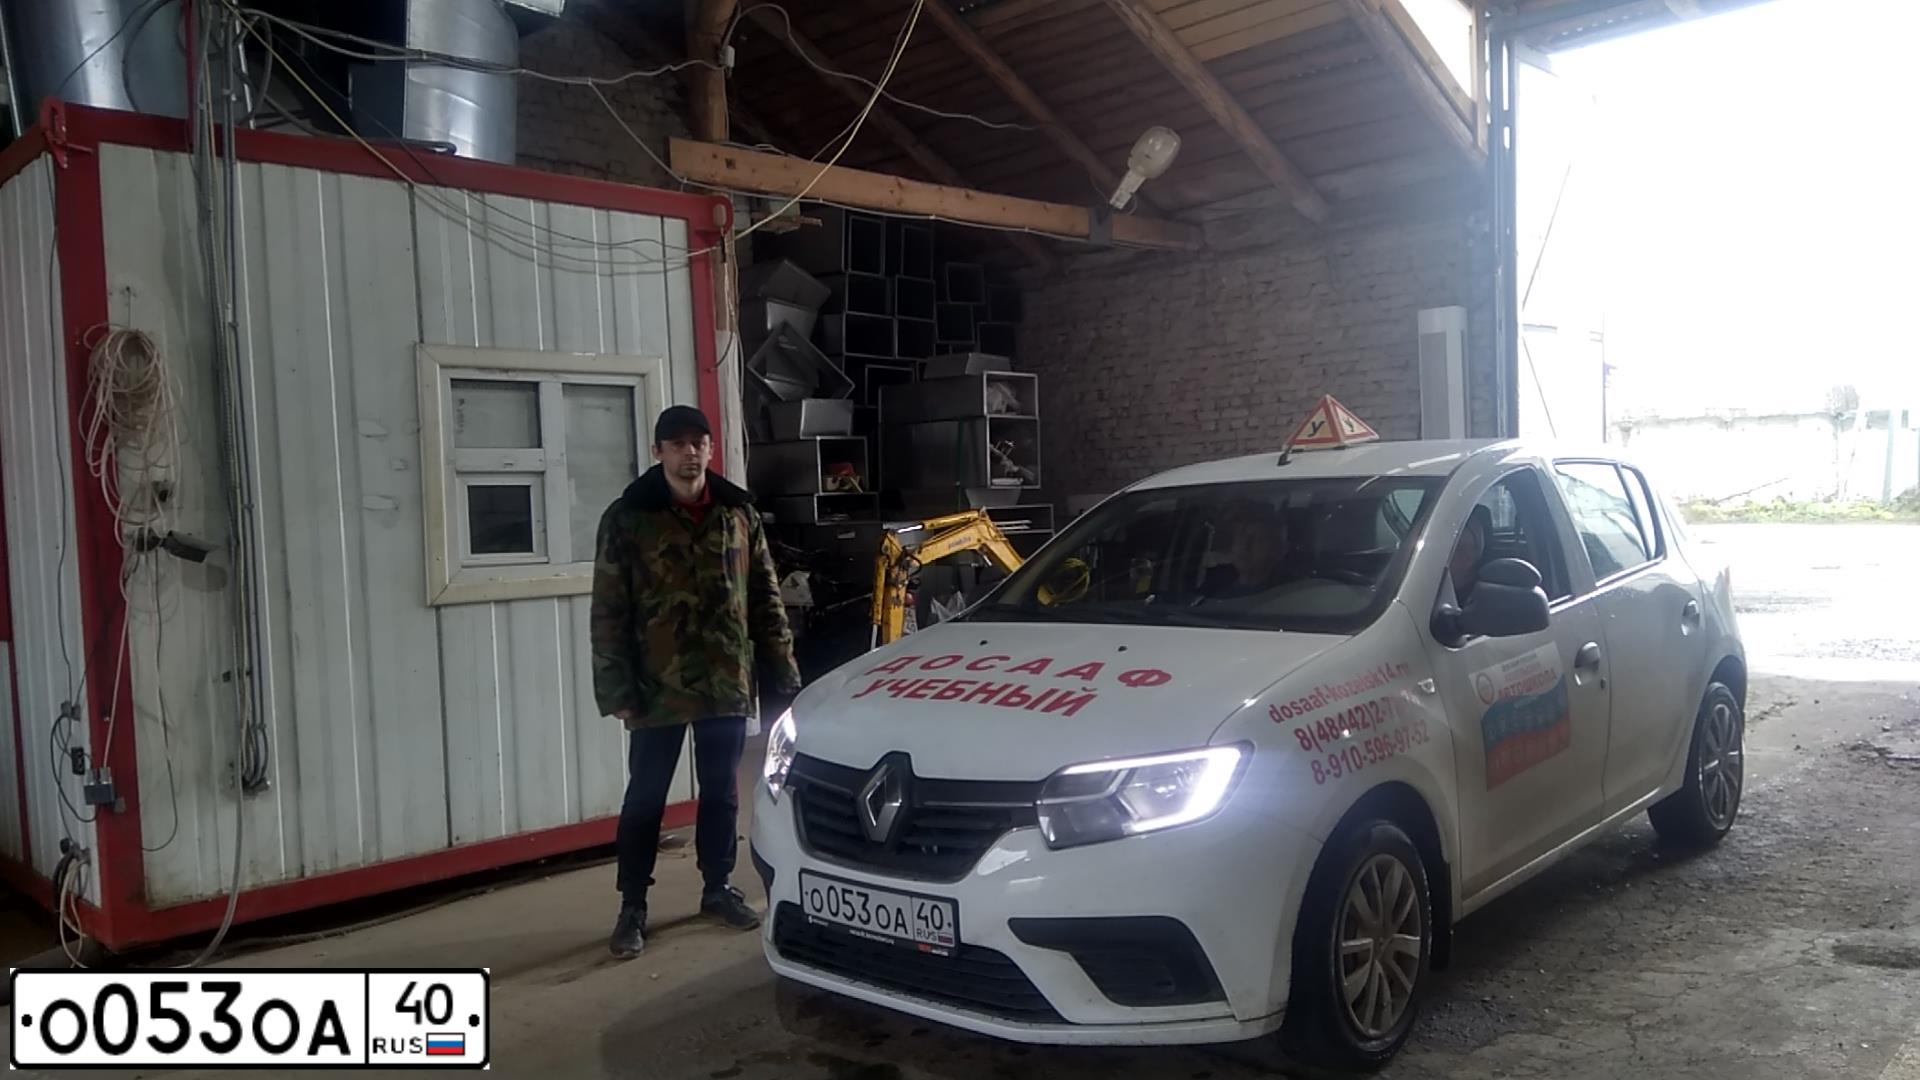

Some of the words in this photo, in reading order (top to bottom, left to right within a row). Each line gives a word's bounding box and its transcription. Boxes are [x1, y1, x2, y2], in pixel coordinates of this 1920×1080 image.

[852, 677, 1099, 718] УЧЕБНЫЙ
[916, 901, 944, 931] 40
[916, 928, 938, 942] RUS
